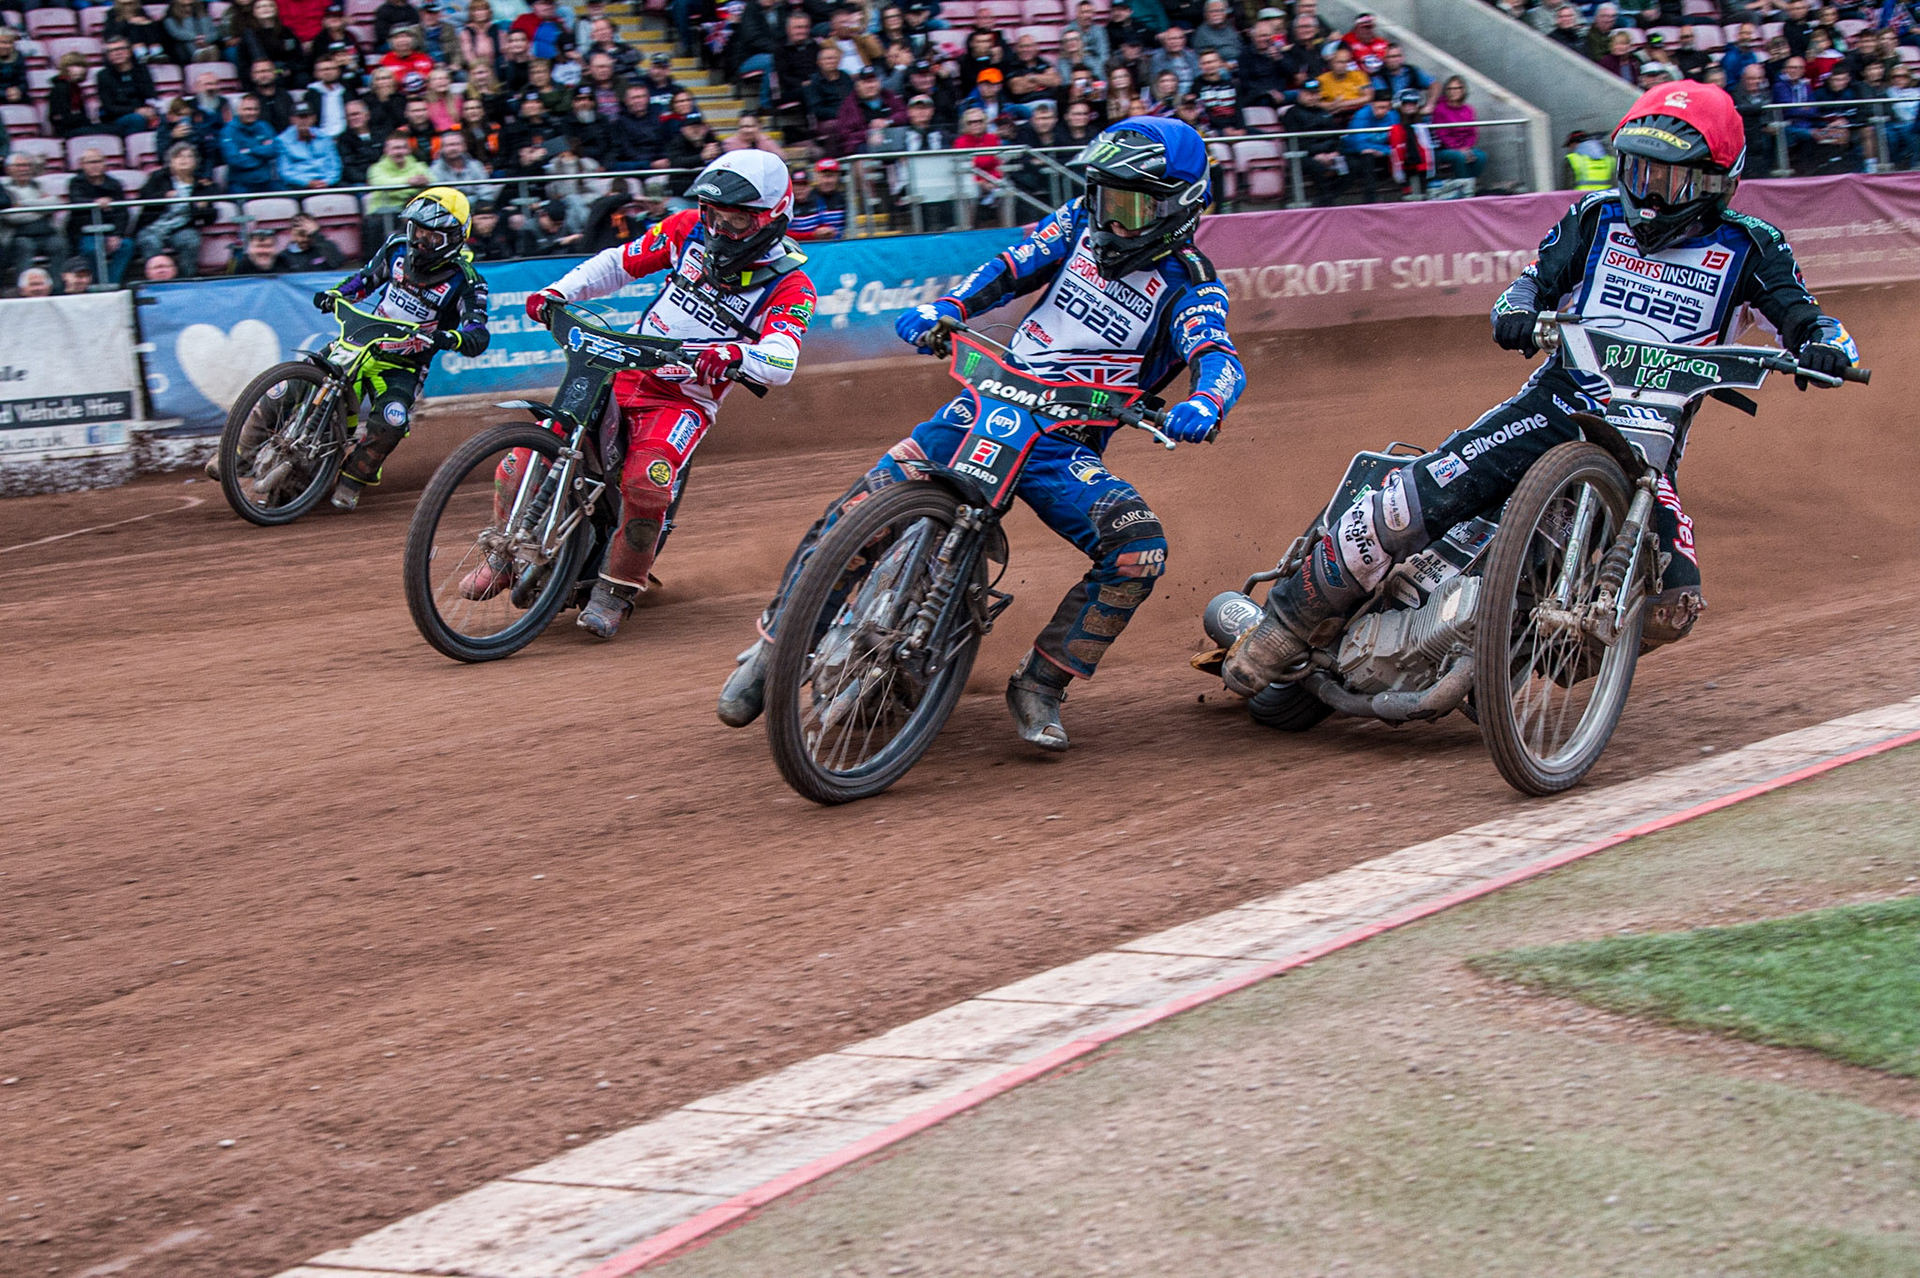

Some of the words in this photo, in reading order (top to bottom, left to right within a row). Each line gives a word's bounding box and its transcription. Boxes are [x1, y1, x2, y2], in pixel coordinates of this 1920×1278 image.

[1617, 235, 1636, 246] SCB
[1607, 251, 1663, 279] SPORTS
[1662, 265, 1718, 293] INSURE
[1701, 250, 1731, 270] 13
[389, 289, 430, 321] 2022
[1062, 278, 1101, 308] BRITISH
[1102, 304, 1133, 330] FINAL
[1069, 257, 1107, 291] SPORTS
[1106, 280, 1152, 318] INSURE
[1605, 273, 1661, 297] BRITISH
[1664, 290, 1704, 310] FINAL
[669, 288, 730, 337] 2022
[1054, 287, 1131, 348] 2022
[1600, 284, 1702, 332] 2022
[1606, 345, 1621, 367] R
[1620, 345, 1637, 369] J
[1641, 346, 1719, 380] Warren
[991, 414, 1015, 430] ATPI
[1461, 413, 1549, 462] Silkolene
[954, 462, 998, 485] BETARD
[1434, 458, 1460, 480] FUCHS
[1409, 555, 1443, 584] WELDING
